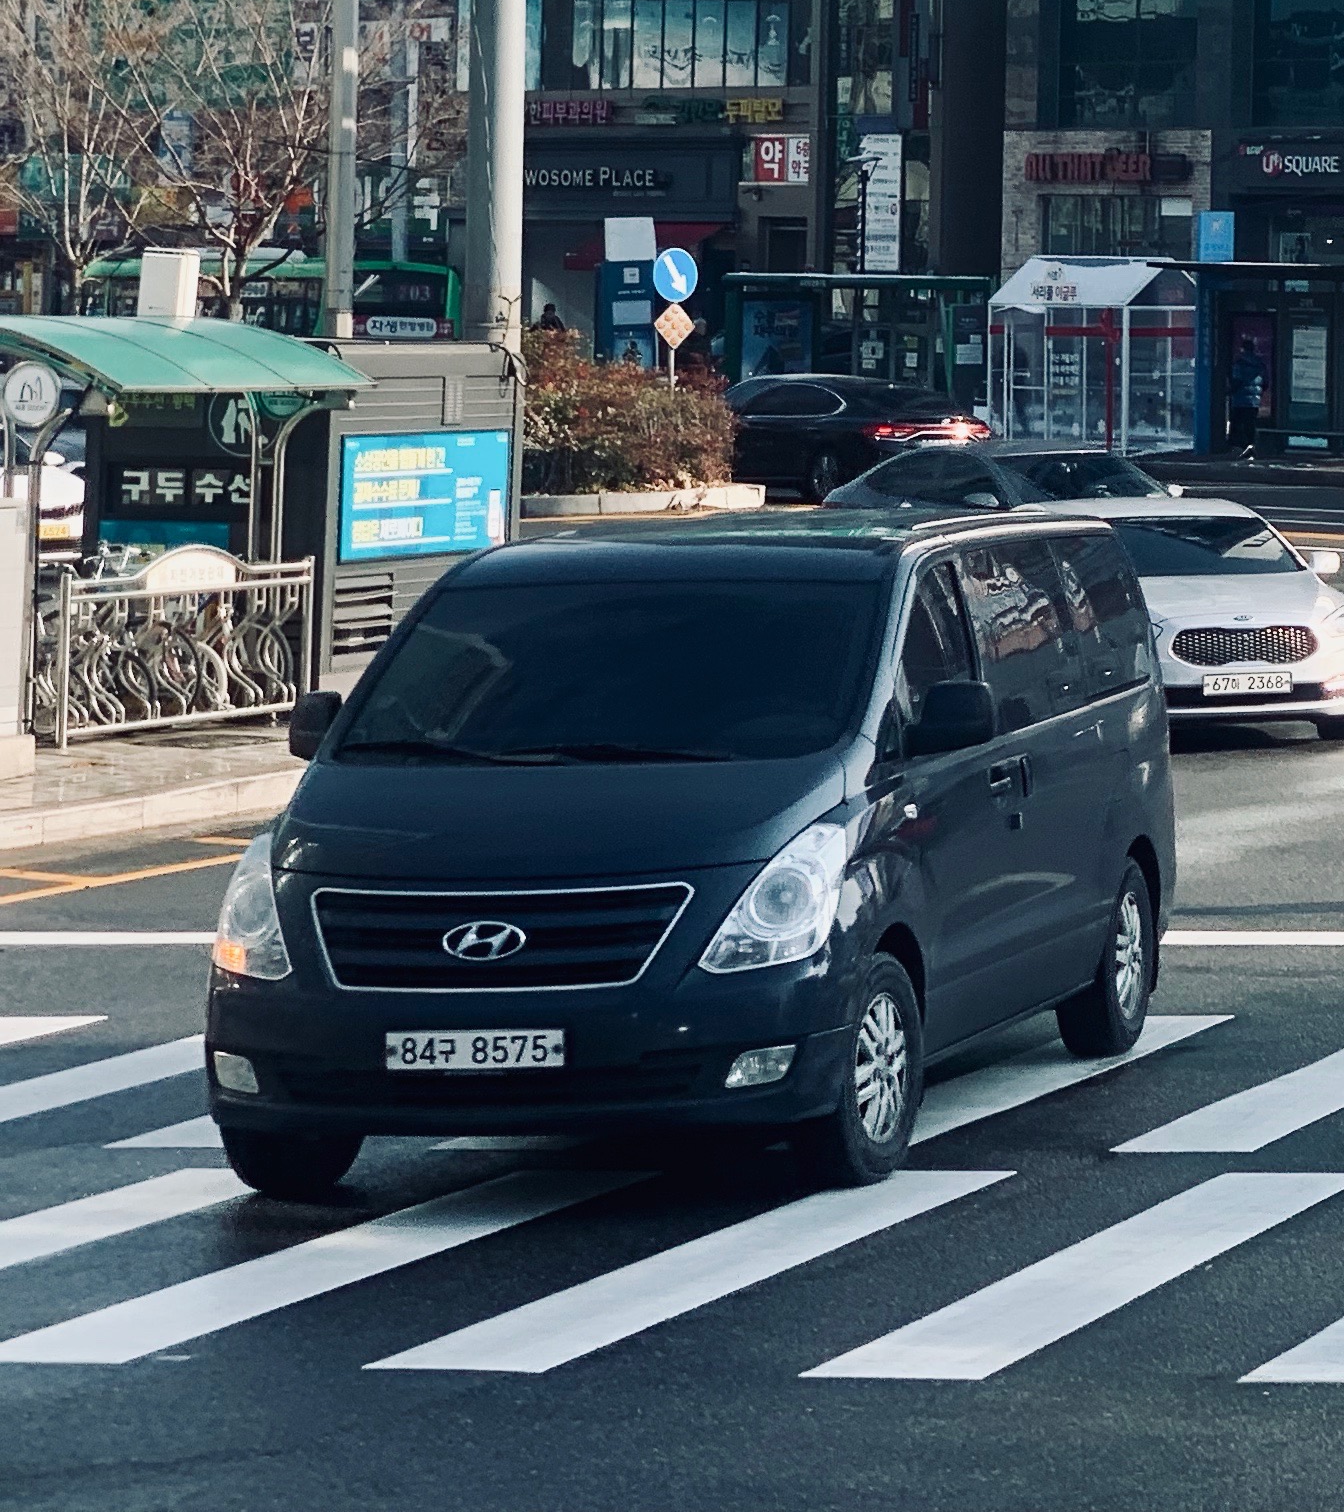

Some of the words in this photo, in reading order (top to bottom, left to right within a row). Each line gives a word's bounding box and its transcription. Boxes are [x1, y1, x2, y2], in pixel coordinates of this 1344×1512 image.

[760, 140, 783, 179] 약
[1283, 156, 1340, 175] SQUARE
[524, 167, 594, 186] WOSOME
[599, 166, 655, 187] PLACE
[1247, 675, 1284, 689] 2368
[401, 1035, 456, 1066] 84구
[471, 1034, 550, 1065] 8575
